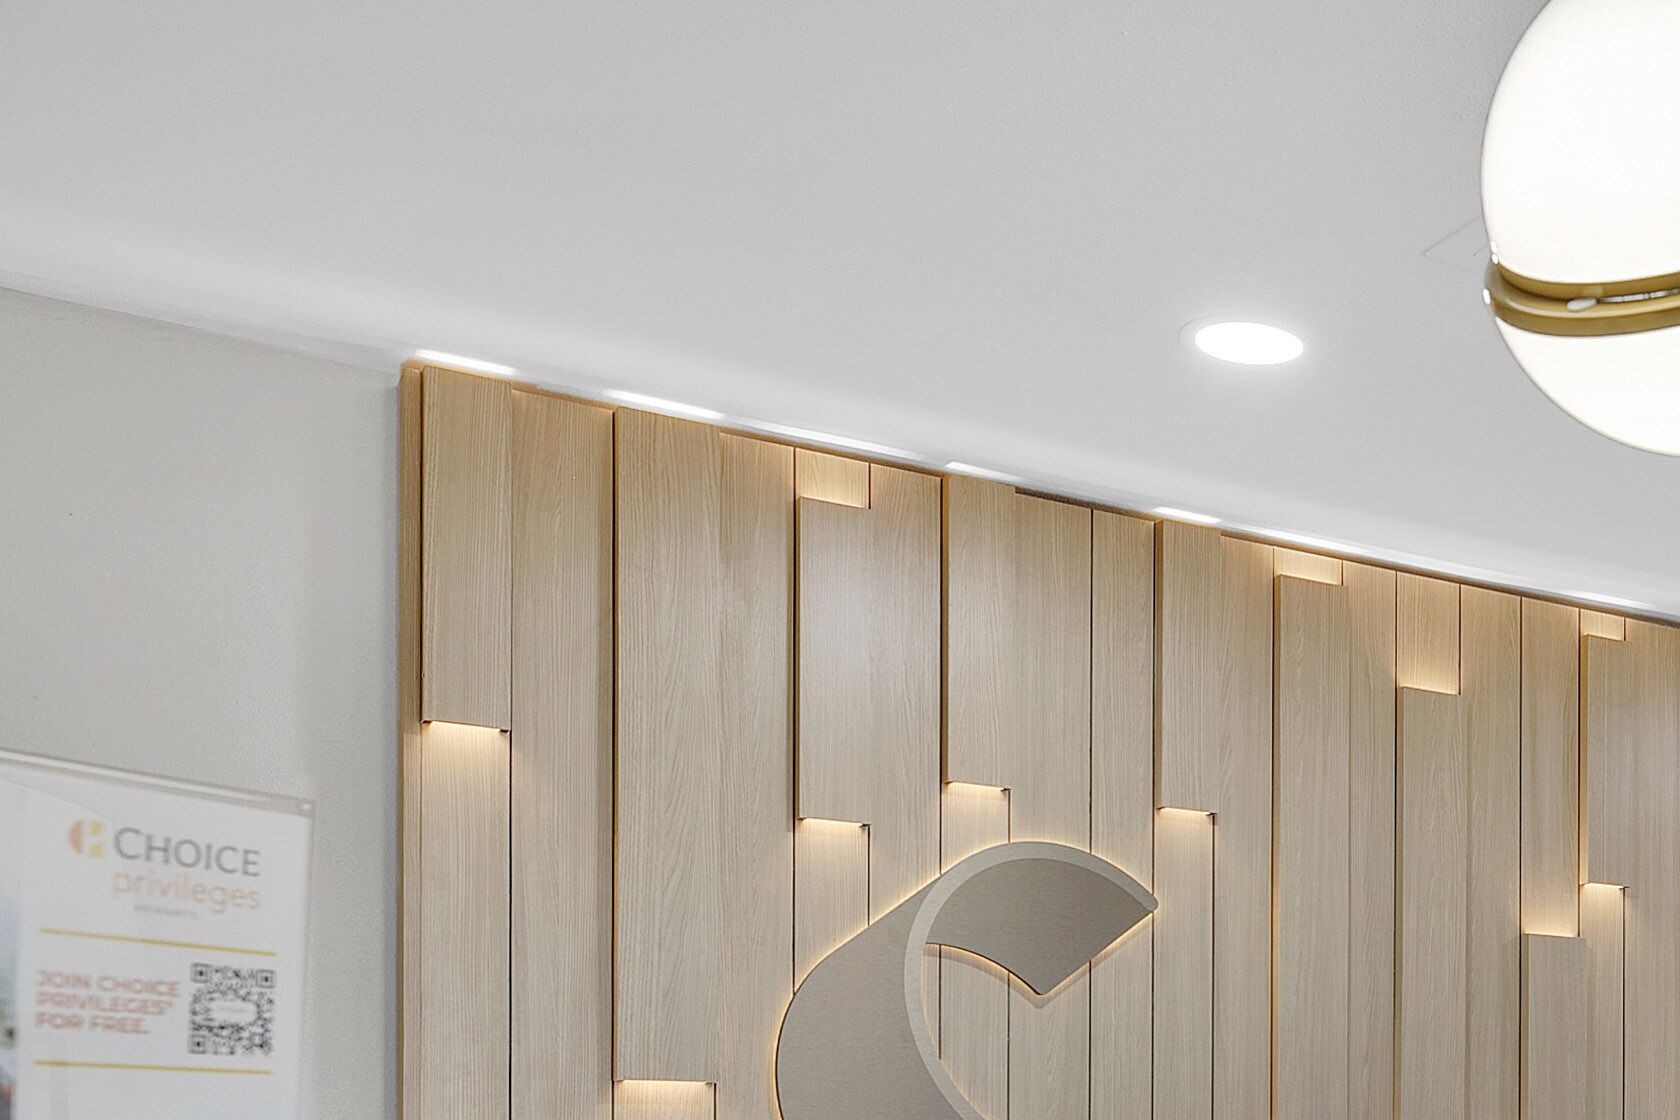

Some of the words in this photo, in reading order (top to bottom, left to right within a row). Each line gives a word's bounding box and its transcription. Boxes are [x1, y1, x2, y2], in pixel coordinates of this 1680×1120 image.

[113, 826, 262, 878] CHOICE
[111, 872, 262, 915] privileges
[37, 970, 92, 990] JOIN
[96, 975, 181, 998] CHOICE
[35, 1011, 84, 1030] FOR
